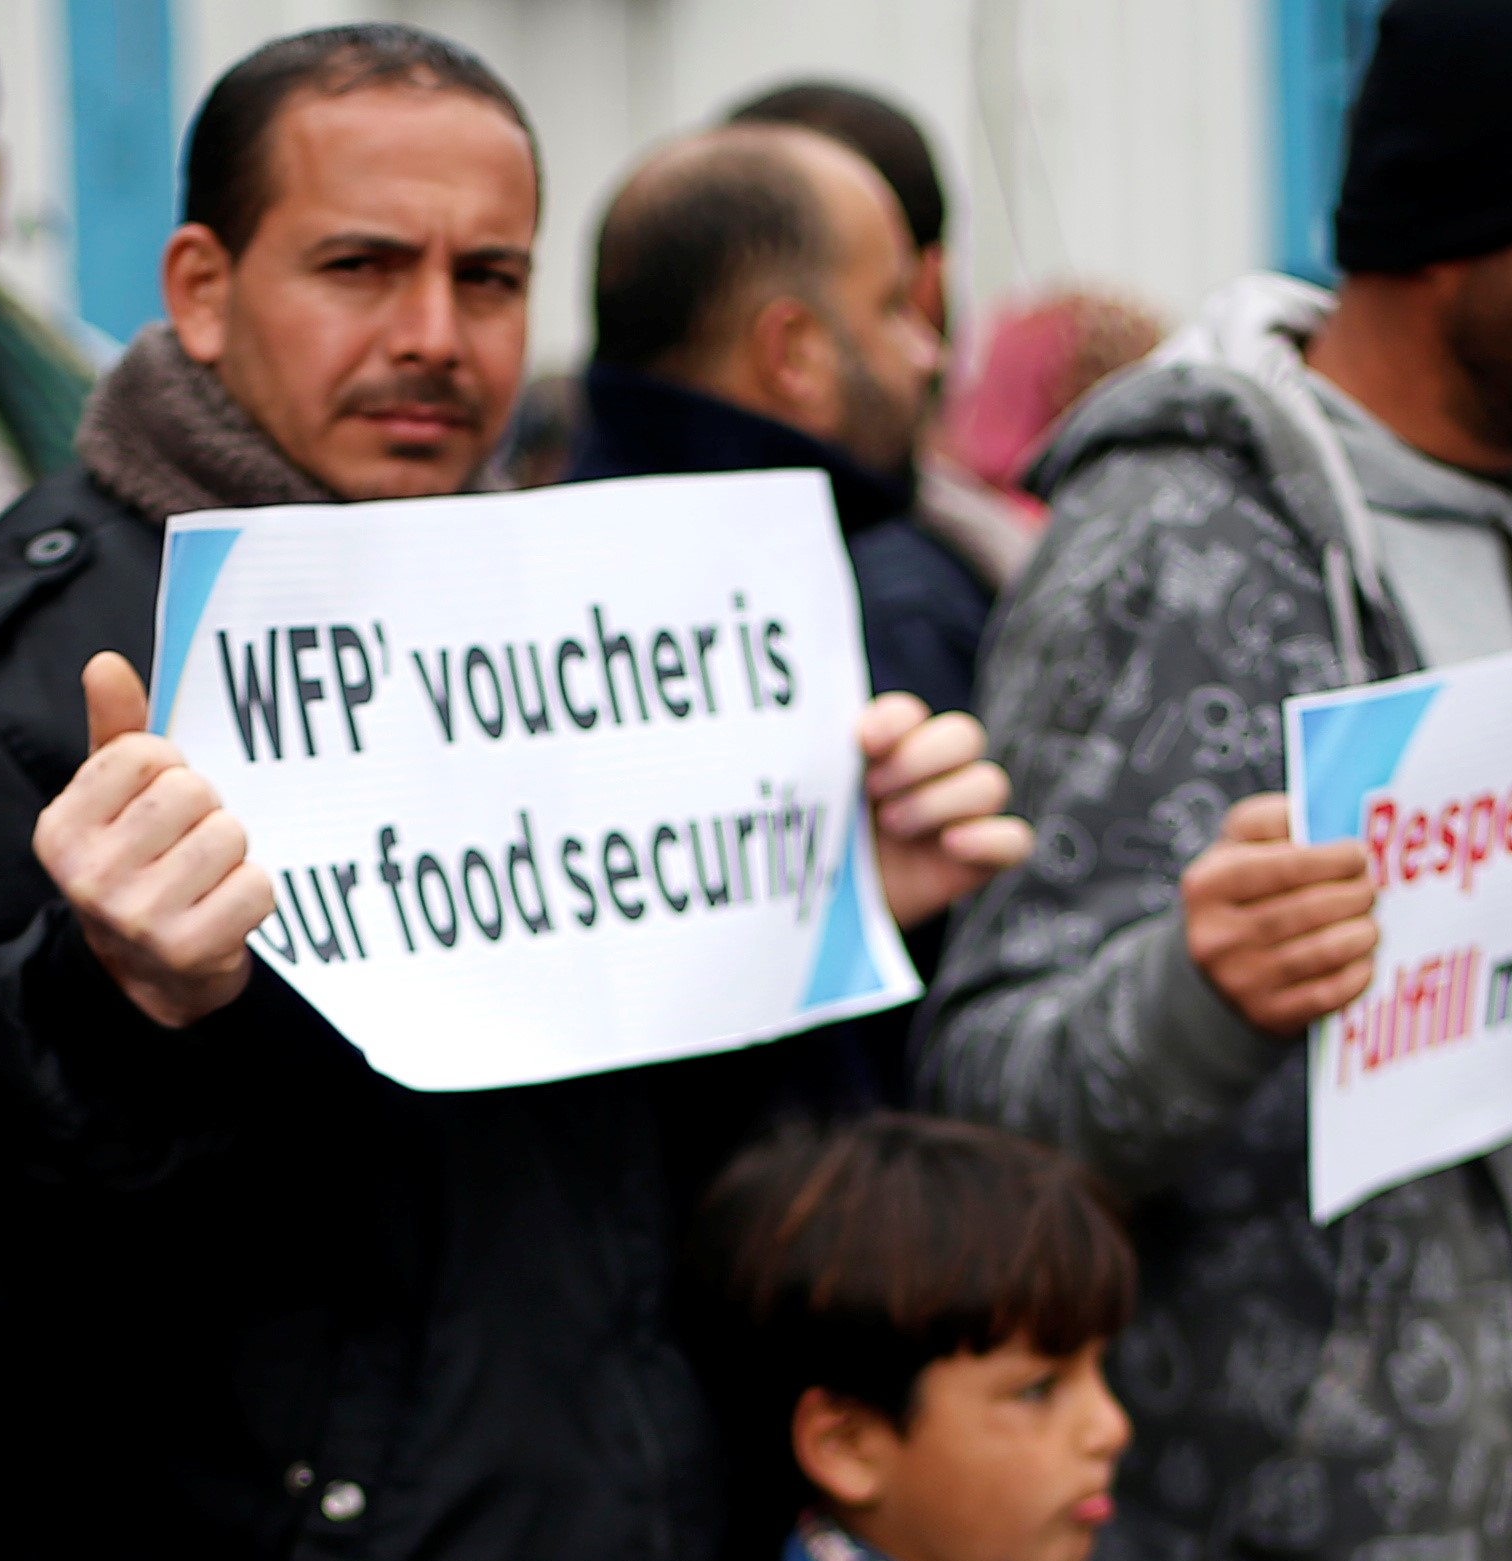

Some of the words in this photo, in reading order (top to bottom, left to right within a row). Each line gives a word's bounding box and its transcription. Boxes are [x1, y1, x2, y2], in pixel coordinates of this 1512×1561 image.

[216, 618, 391, 763] WFP'
[410, 602, 718, 743] voucher
[731, 591, 796, 708] is
[377, 808, 554, 955] food
